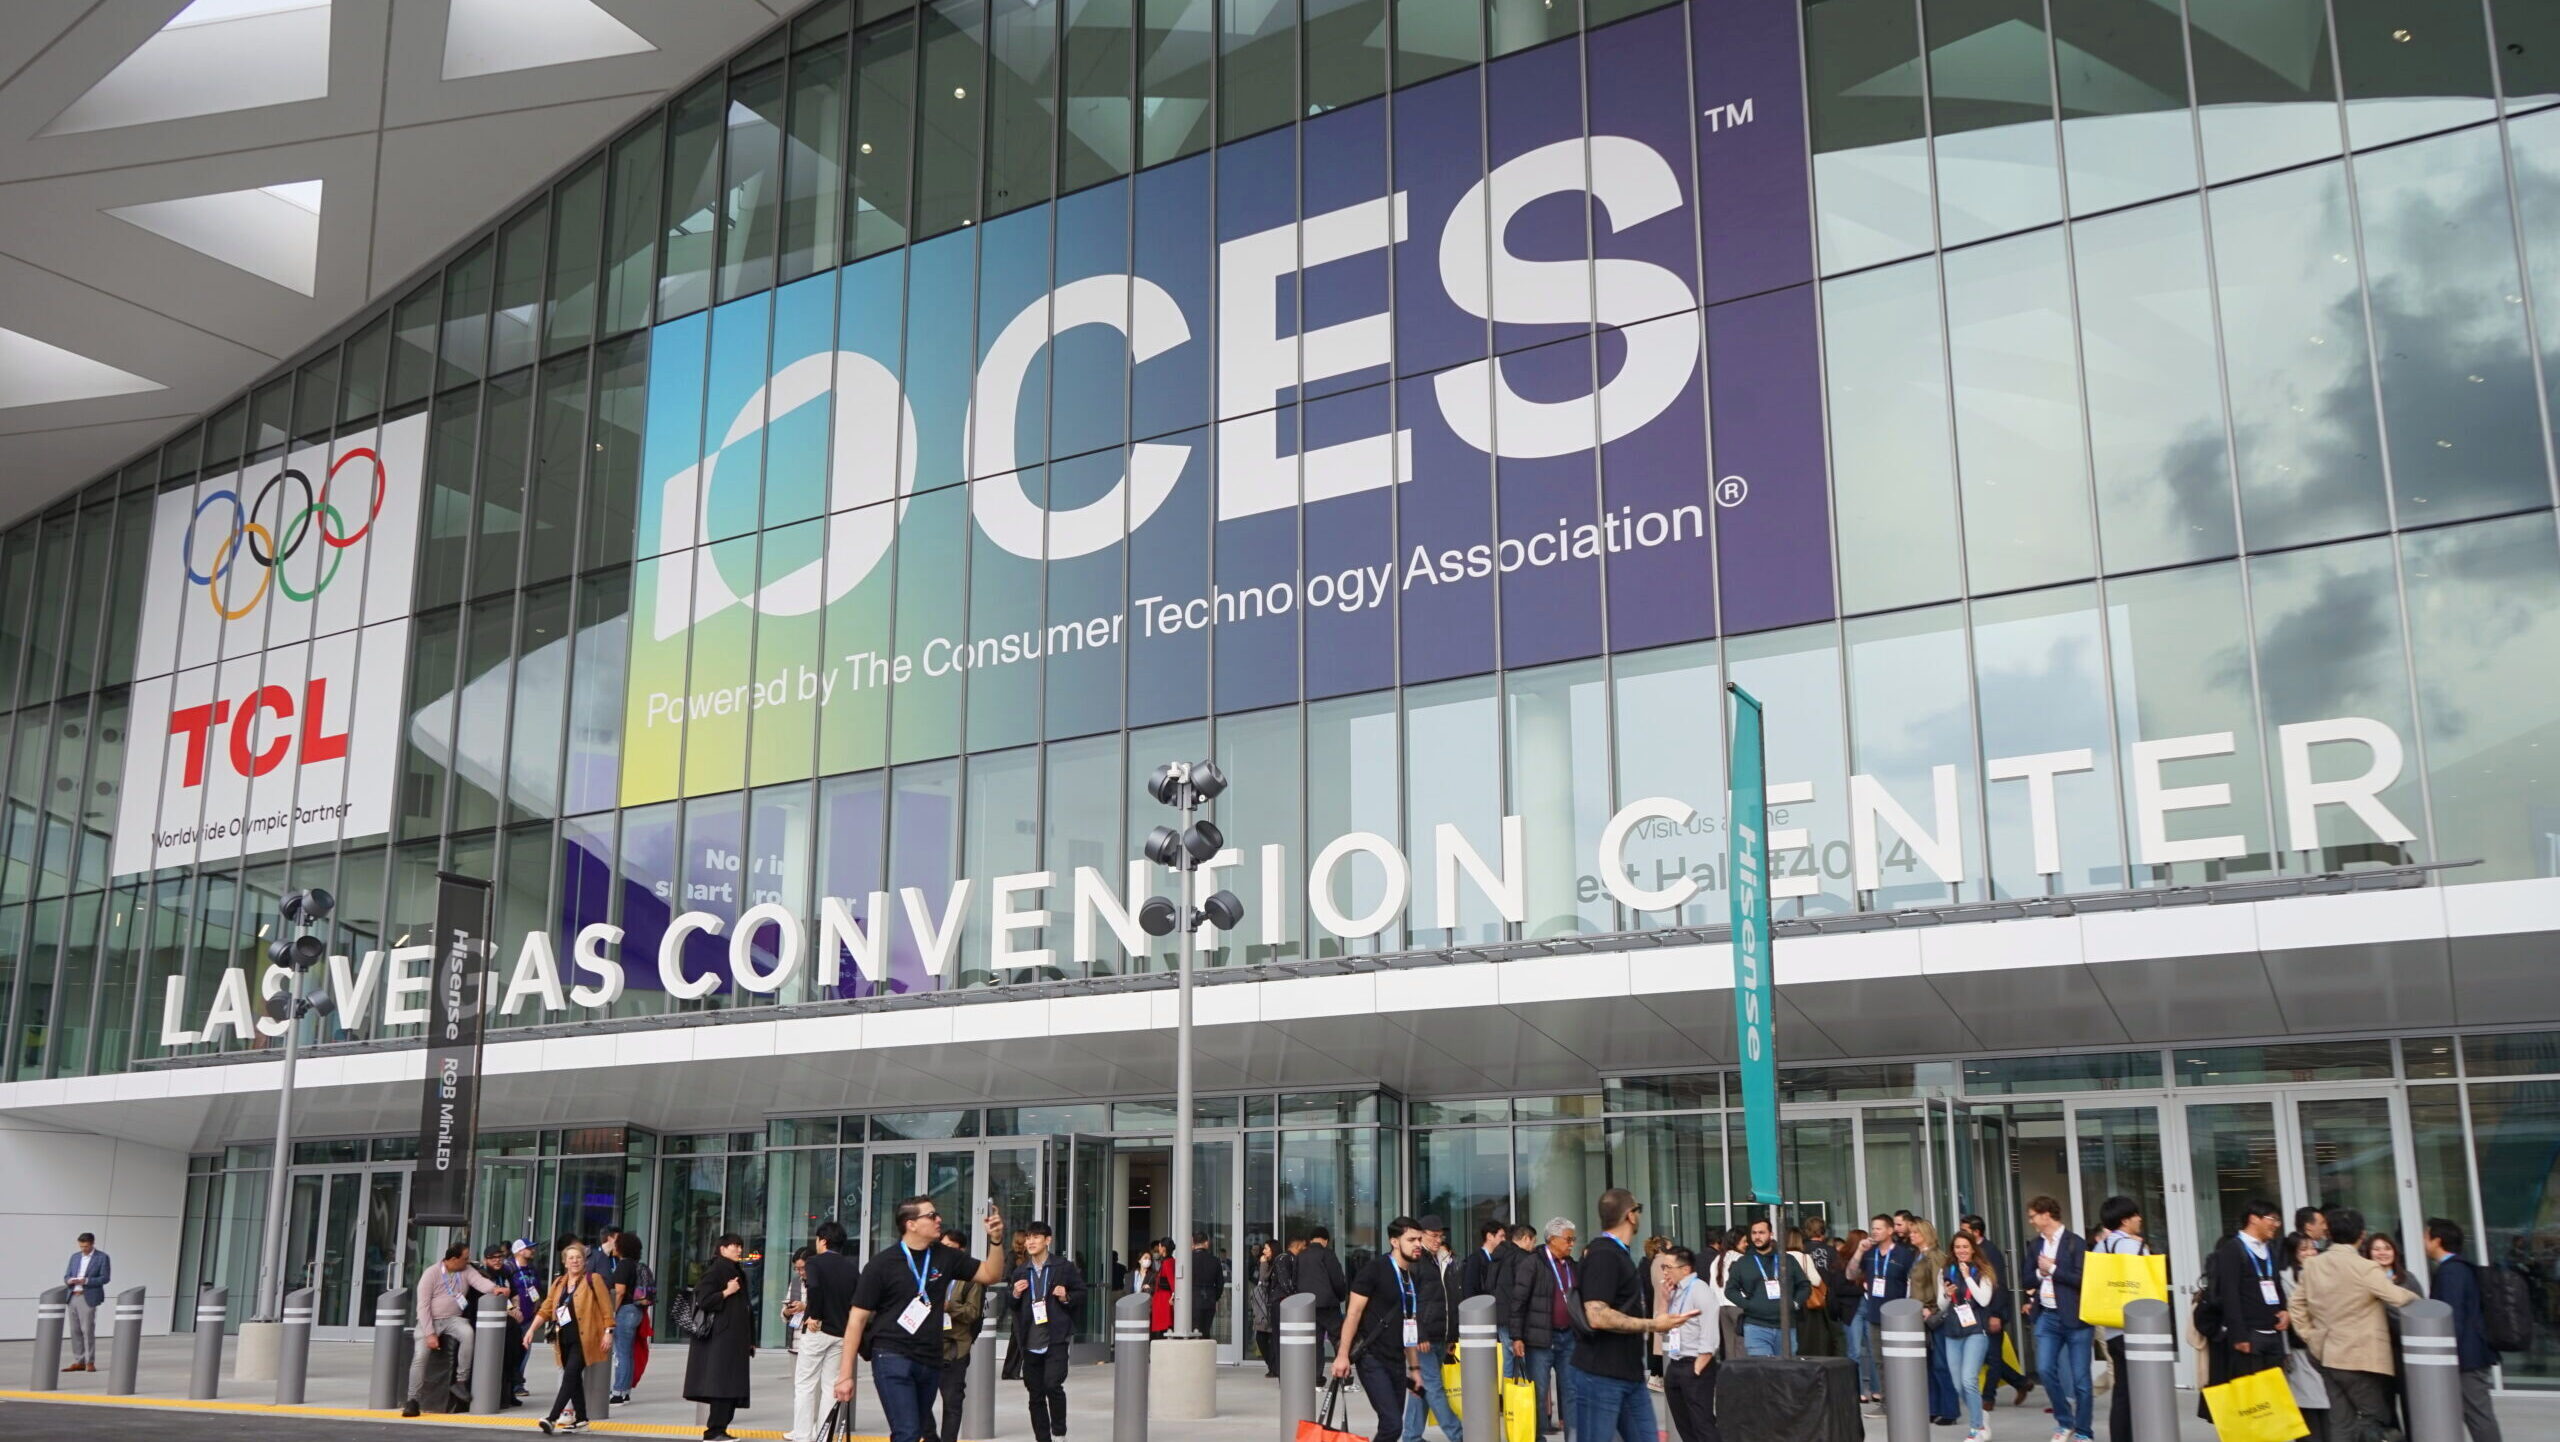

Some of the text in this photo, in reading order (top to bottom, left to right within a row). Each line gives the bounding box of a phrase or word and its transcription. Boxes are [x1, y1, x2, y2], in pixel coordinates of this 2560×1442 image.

[963, 134, 1701, 561] CES
[646, 667, 788, 728] Powered
[796, 663, 838, 711] by
[845, 650, 913, 692] The
[922, 614, 1125, 677] Consumer
[1134, 561, 1394, 638] Technology
[1402, 504, 1704, 590] Association
[152, 802, 353, 849] Worldwide Olympic Partner
[169, 677, 349, 788] TCL
[1636, 817, 1683, 841] Visit
[329, 922, 625, 1029] VEGAS
[658, 815, 1528, 1000] CONVENTION
[1599, 717, 2417, 911] CENTER
[1737, 823, 1761, 1063] Hisense
[435, 928, 470, 1172] Hisense RGB MiniLED
